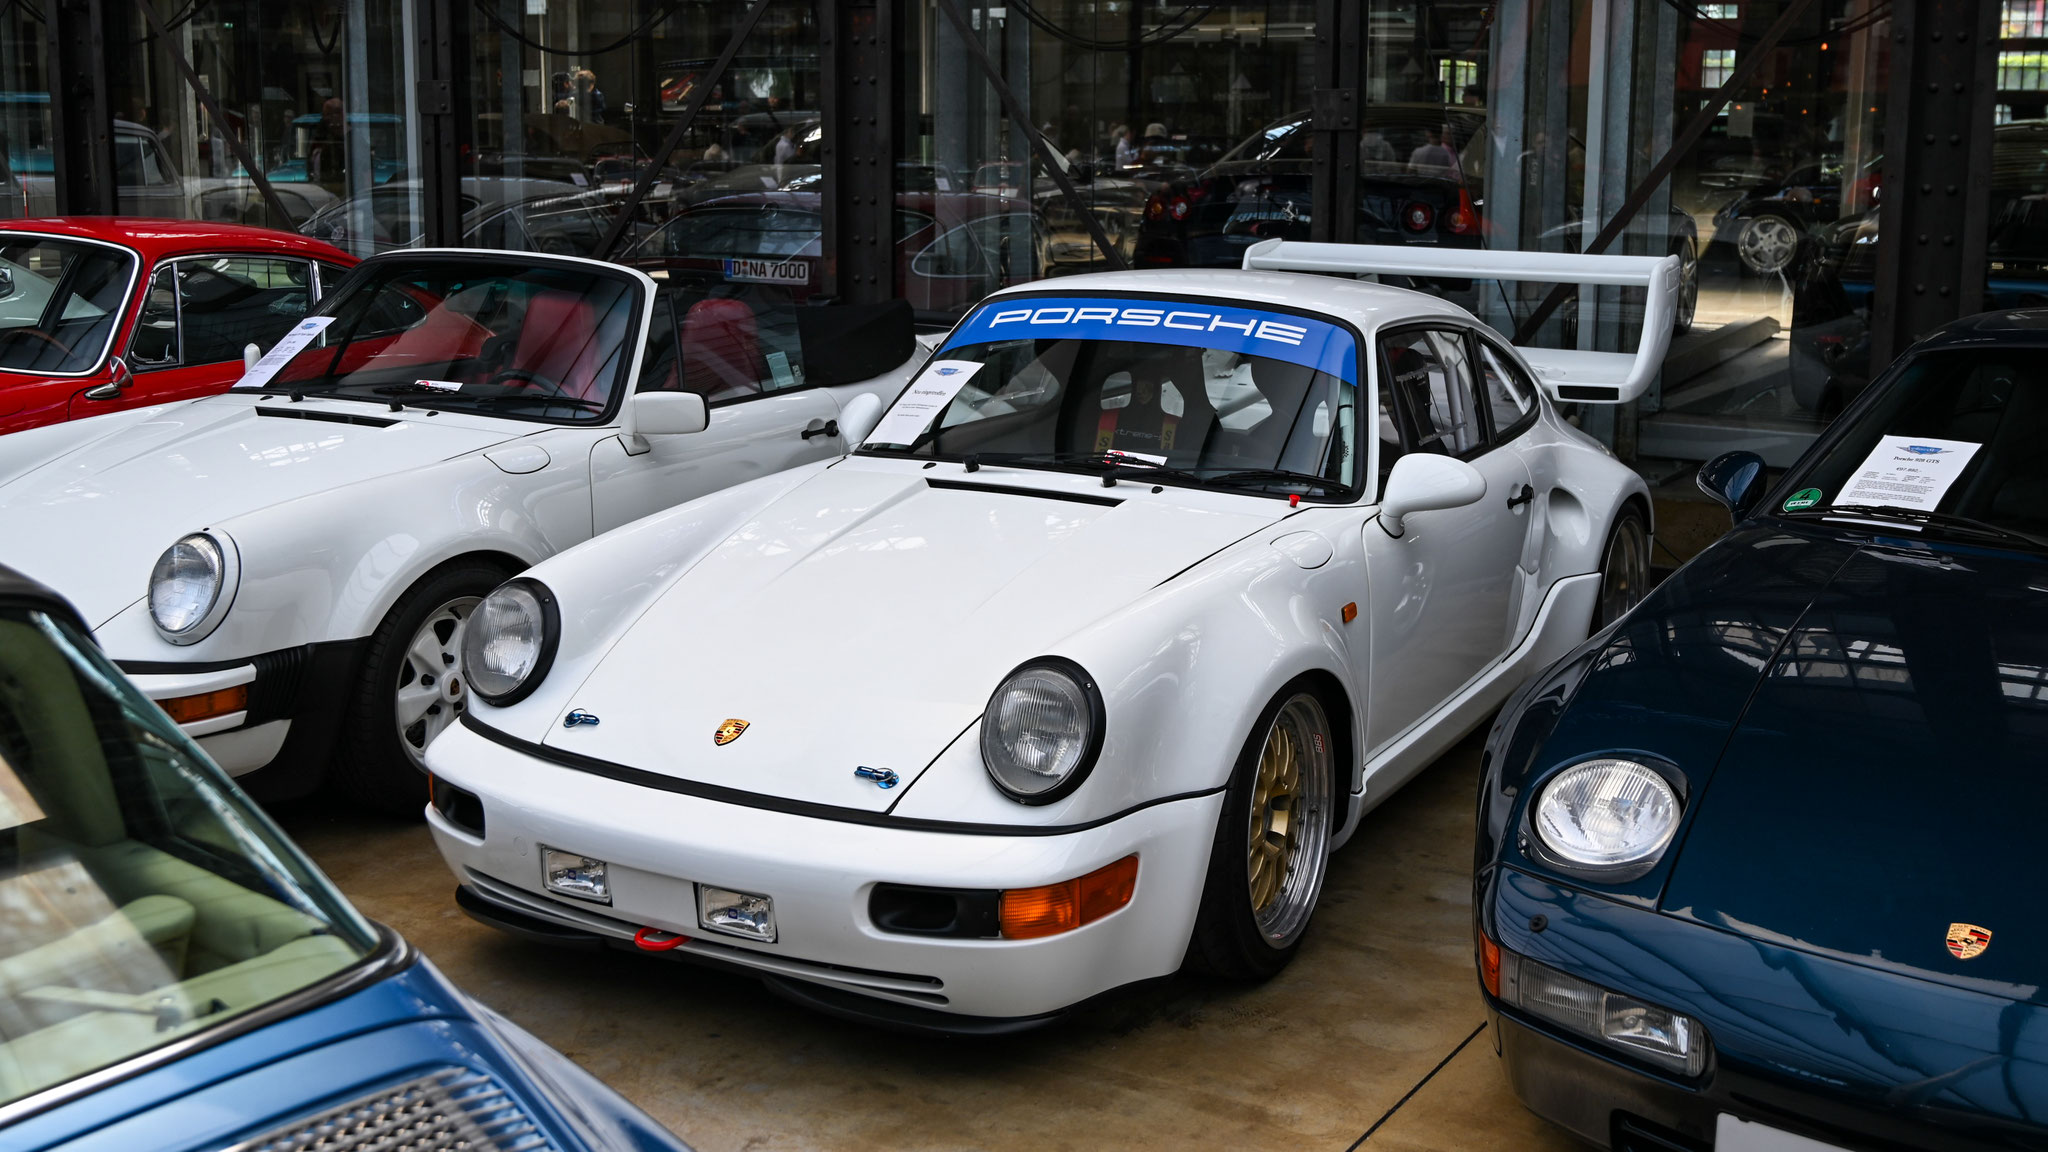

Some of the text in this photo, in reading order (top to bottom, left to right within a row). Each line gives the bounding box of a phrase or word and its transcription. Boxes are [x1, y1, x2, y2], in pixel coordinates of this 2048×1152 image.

[733, 260, 806, 280] D NA 7000
[988, 307, 1308, 346] PORSCHE
[1799, 489, 1813, 500] 4
[1313, 733, 1323, 753] BBS
